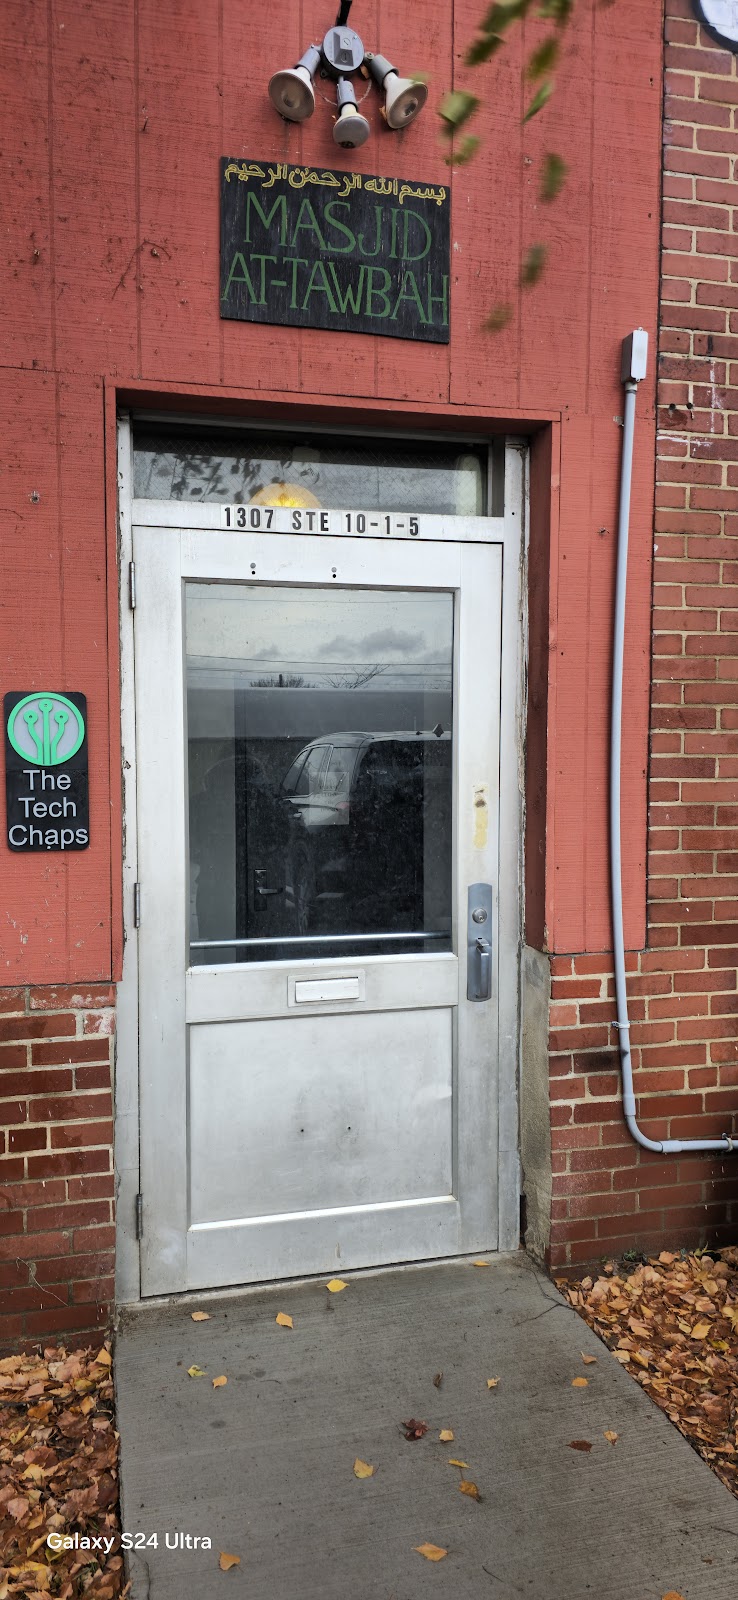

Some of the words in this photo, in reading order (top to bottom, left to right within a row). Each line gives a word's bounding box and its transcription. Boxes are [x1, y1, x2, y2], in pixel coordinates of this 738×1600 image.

[224, 162, 289, 188] الرحيم
[399, 184, 447, 206] بسم
[243, 191, 432, 261] MASJID
[220, 251, 449, 326] AT-TAWBAH
[224, 507, 274, 529] 1307
[292, 510, 330, 532] STE
[345, 513, 419, 536] 10-1-5
[22, 769, 72, 791] The
[18, 796, 77, 818] Tech
[8, 824, 89, 849] Chaps
